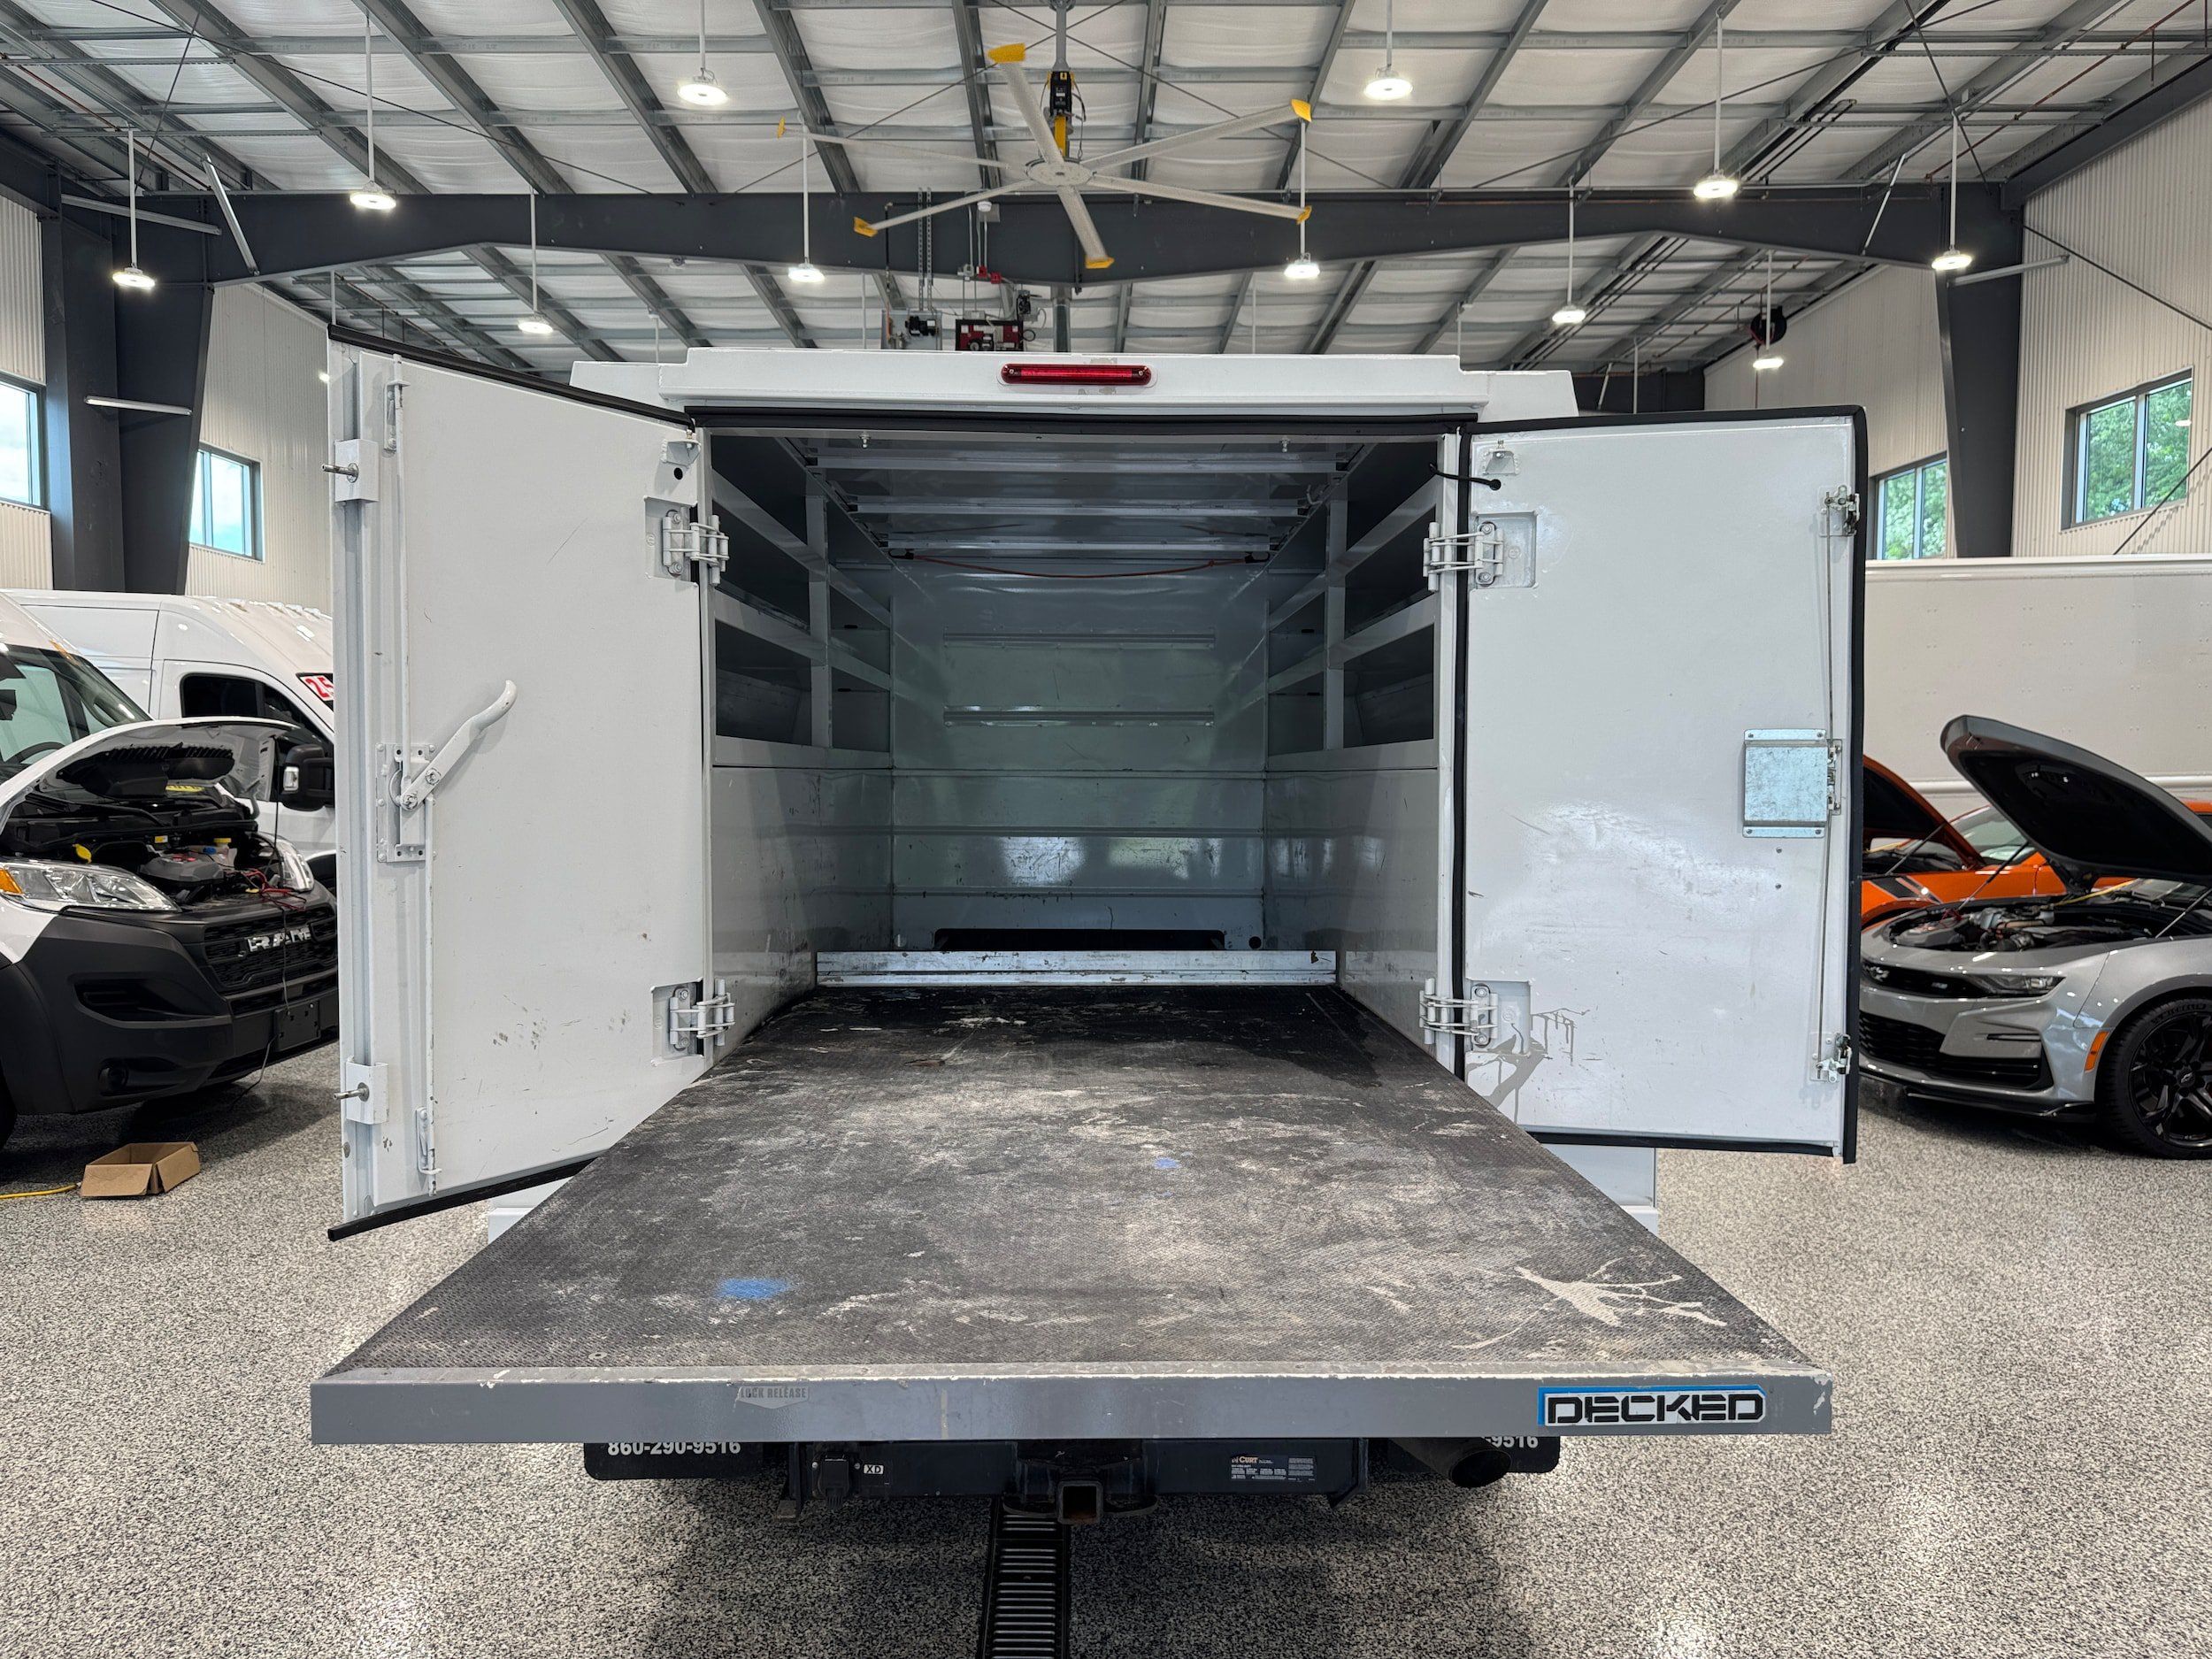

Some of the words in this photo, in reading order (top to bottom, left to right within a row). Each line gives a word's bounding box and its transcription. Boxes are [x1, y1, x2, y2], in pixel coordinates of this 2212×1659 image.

[248, 926, 311, 951] RAM
[741, 1387, 764, 1398] LOCK
[767, 1387, 806, 1398] RELEASE
[1548, 1394, 1763, 1424] DECKED
[607, 1442, 741, 1455] 860-290-9516
